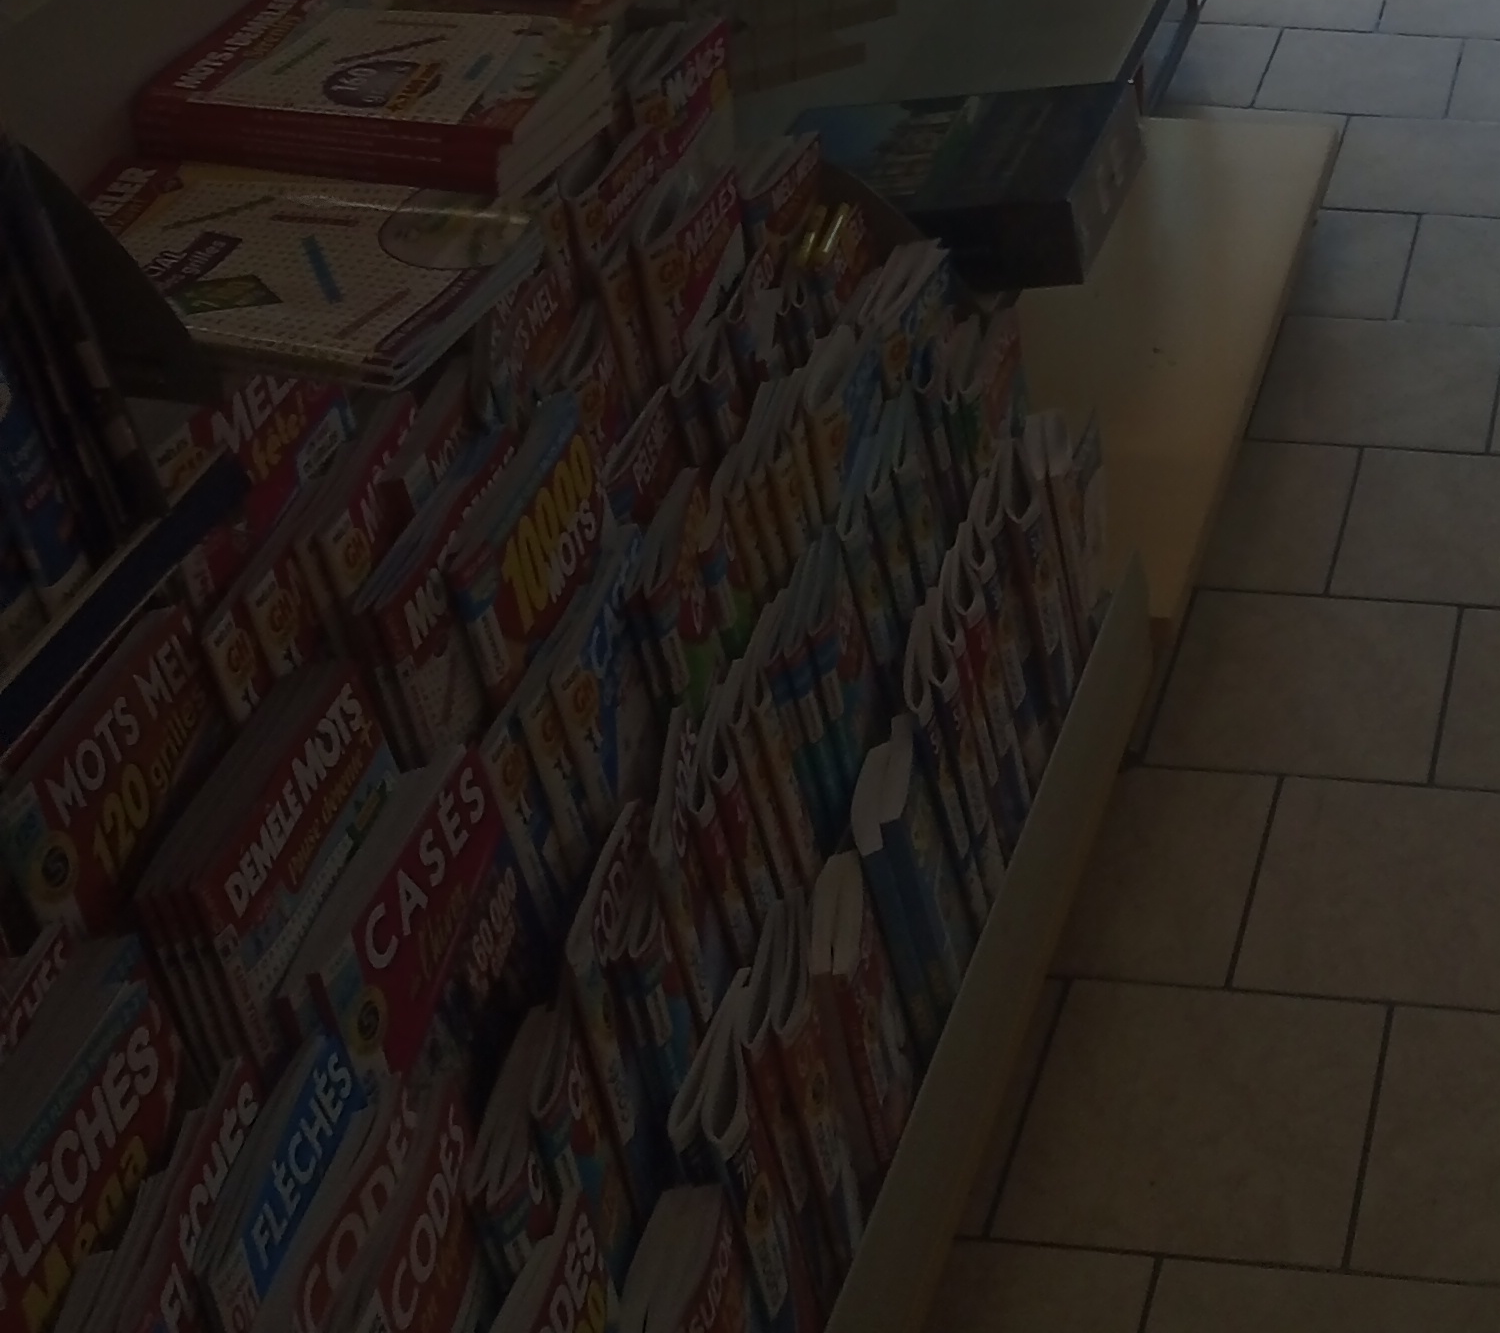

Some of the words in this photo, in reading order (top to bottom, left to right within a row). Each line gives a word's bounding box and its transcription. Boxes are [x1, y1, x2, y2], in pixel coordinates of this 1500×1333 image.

[547, 499, 598, 605] MOTS
[44, 695, 141, 829] MOTS
[92, 762, 151, 885] 120
